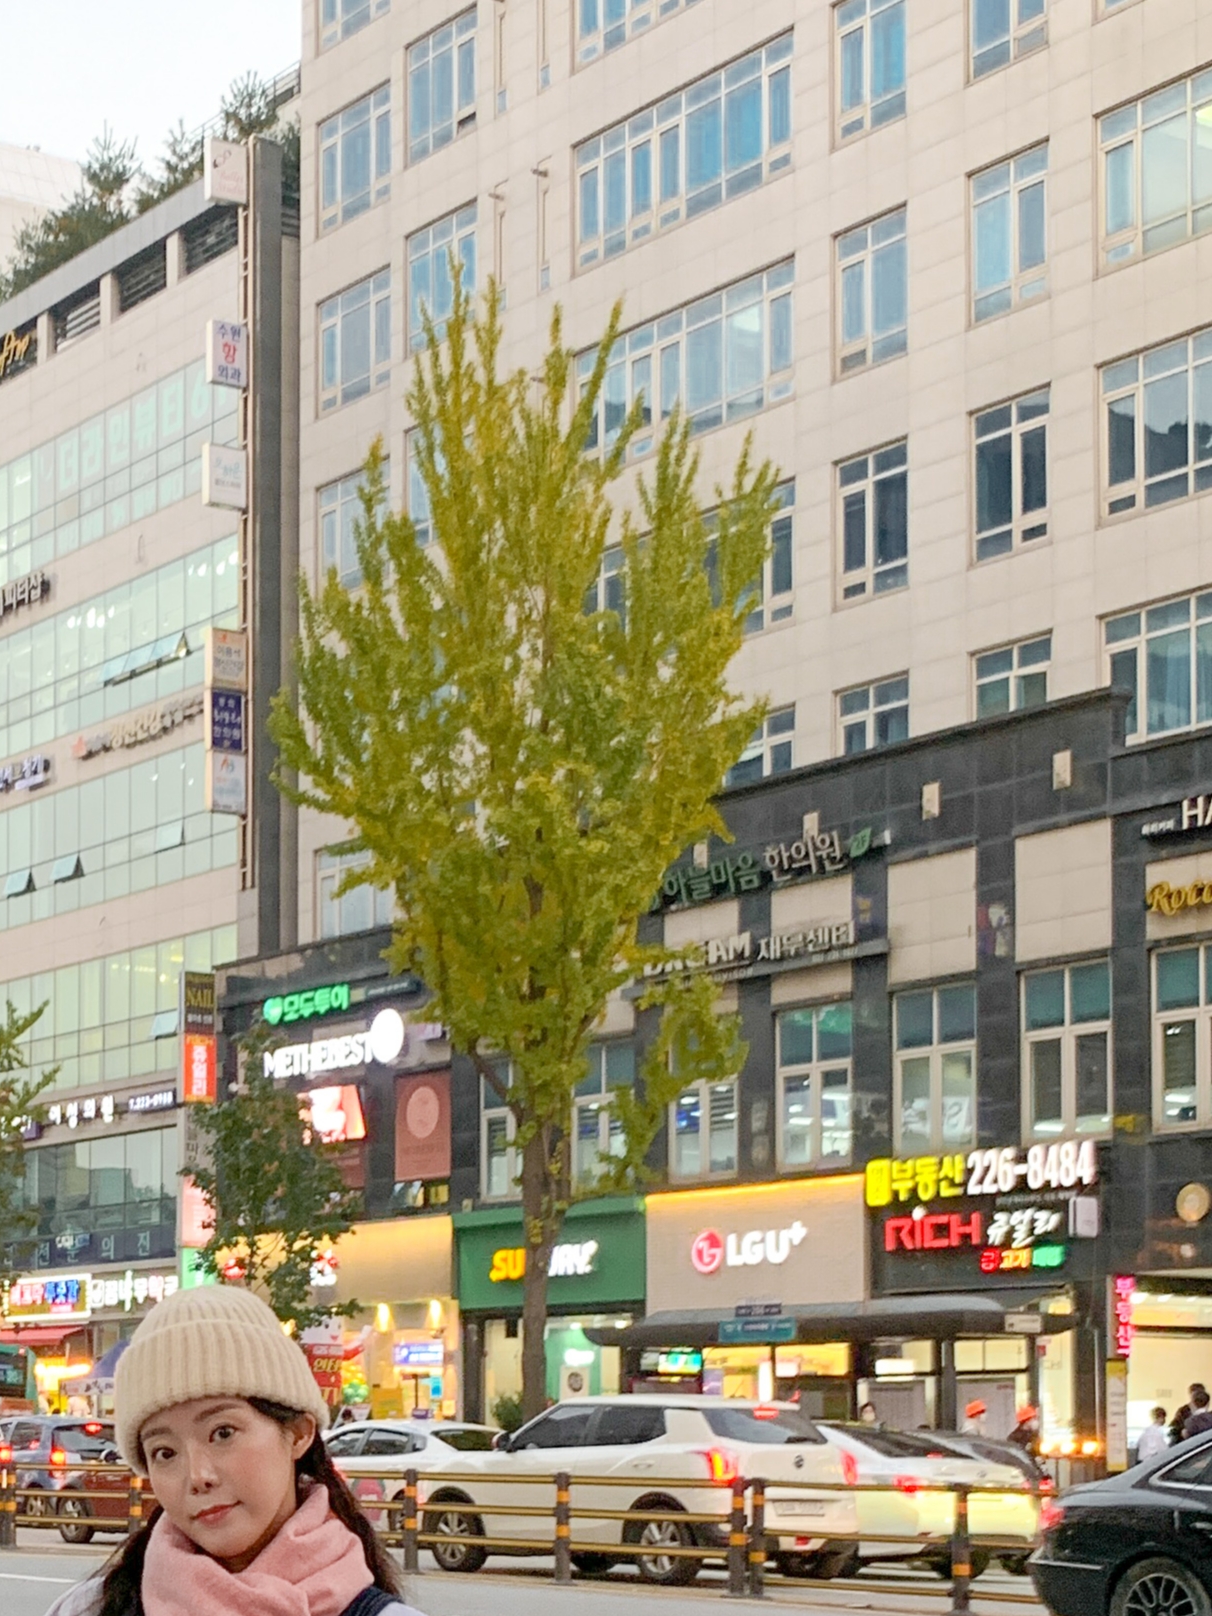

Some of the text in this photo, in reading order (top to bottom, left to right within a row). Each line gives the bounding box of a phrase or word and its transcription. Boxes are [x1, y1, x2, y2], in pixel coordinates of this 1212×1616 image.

[217, 324, 242, 342] 수원
[218, 364, 242, 382] 외과
[663, 851, 761, 902] 하늘마음
[762, 831, 848, 882] 한의원
[892, 1153, 964, 1202] 부동산
[966, 1140, 1096, 1195] 226-8484
[885, 1205, 982, 1251] RICH
